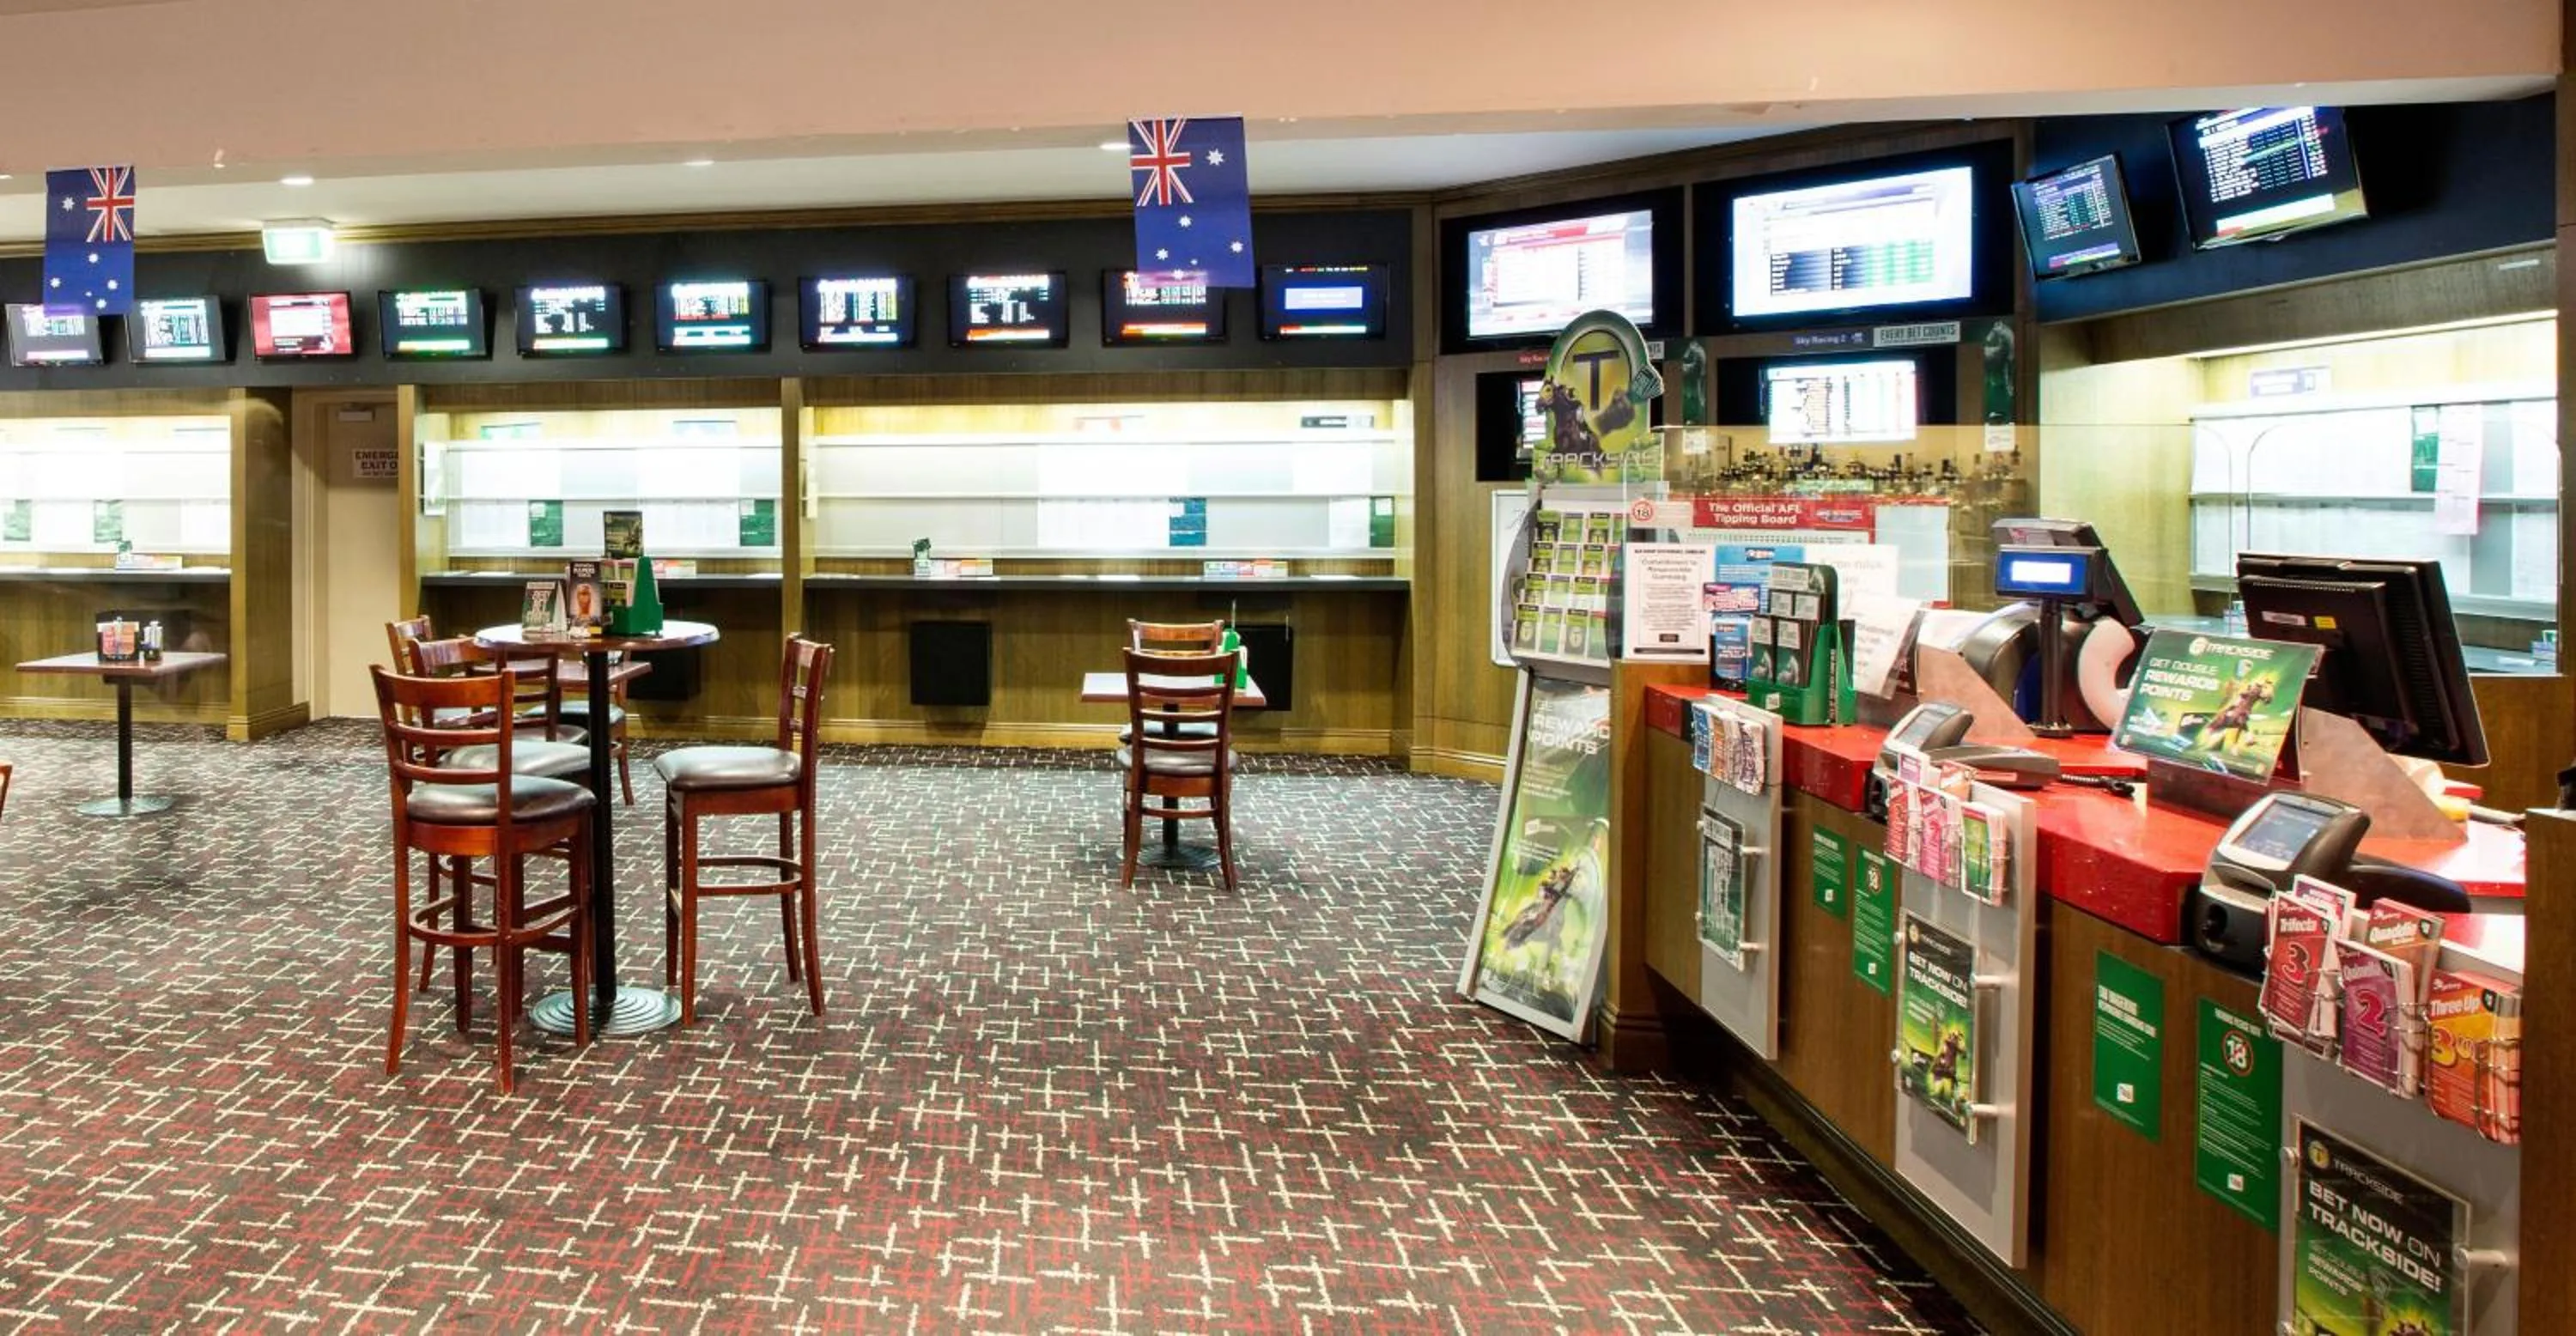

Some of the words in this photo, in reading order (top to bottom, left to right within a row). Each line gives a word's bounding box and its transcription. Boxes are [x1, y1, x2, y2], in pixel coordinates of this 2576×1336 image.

[1908, 327, 1922, 338] BET
[1572, 350, 1619, 411] T
[361, 461, 386, 470] EXIT
[1708, 501, 1728, 513] The
[1732, 501, 1775, 513] Official
[1778, 503, 1802, 513] AFL
[1714, 514, 1758, 525] Tipping
[1760, 514, 1797, 525] Board
[2206, 642, 2275, 660] TRACKSIDE
[2149, 657, 2171, 669] GET
[2172, 659, 2219, 675] DOUBLE
[2139, 683, 2195, 701] POINTS
[2145, 669, 2221, 691] REWARDS
[1533, 714, 1611, 739] REWARD
[1530, 730, 1597, 755] POINTS
[2280, 917, 2318, 933] Trifecta
[1909, 950, 1926, 969] BET
[1928, 961, 1952, 983] NOW
[2281, 942, 2310, 984] 3
[2355, 989, 2387, 1036] 2
[2431, 999, 2462, 1017] Three
[2464, 995, 2482, 1013] Up
[2431, 1026, 2457, 1066] 3
[2333, 1158, 2404, 1204] TRACKSIDE
[2309, 1181, 2348, 1212] BET
[2352, 1203, 2403, 1244] NOW
[2407, 1236, 2441, 1268] ON
[2309, 1201, 2443, 1293] TRACKSIDE!
[2307, 1266, 2348, 1296] POINTS
